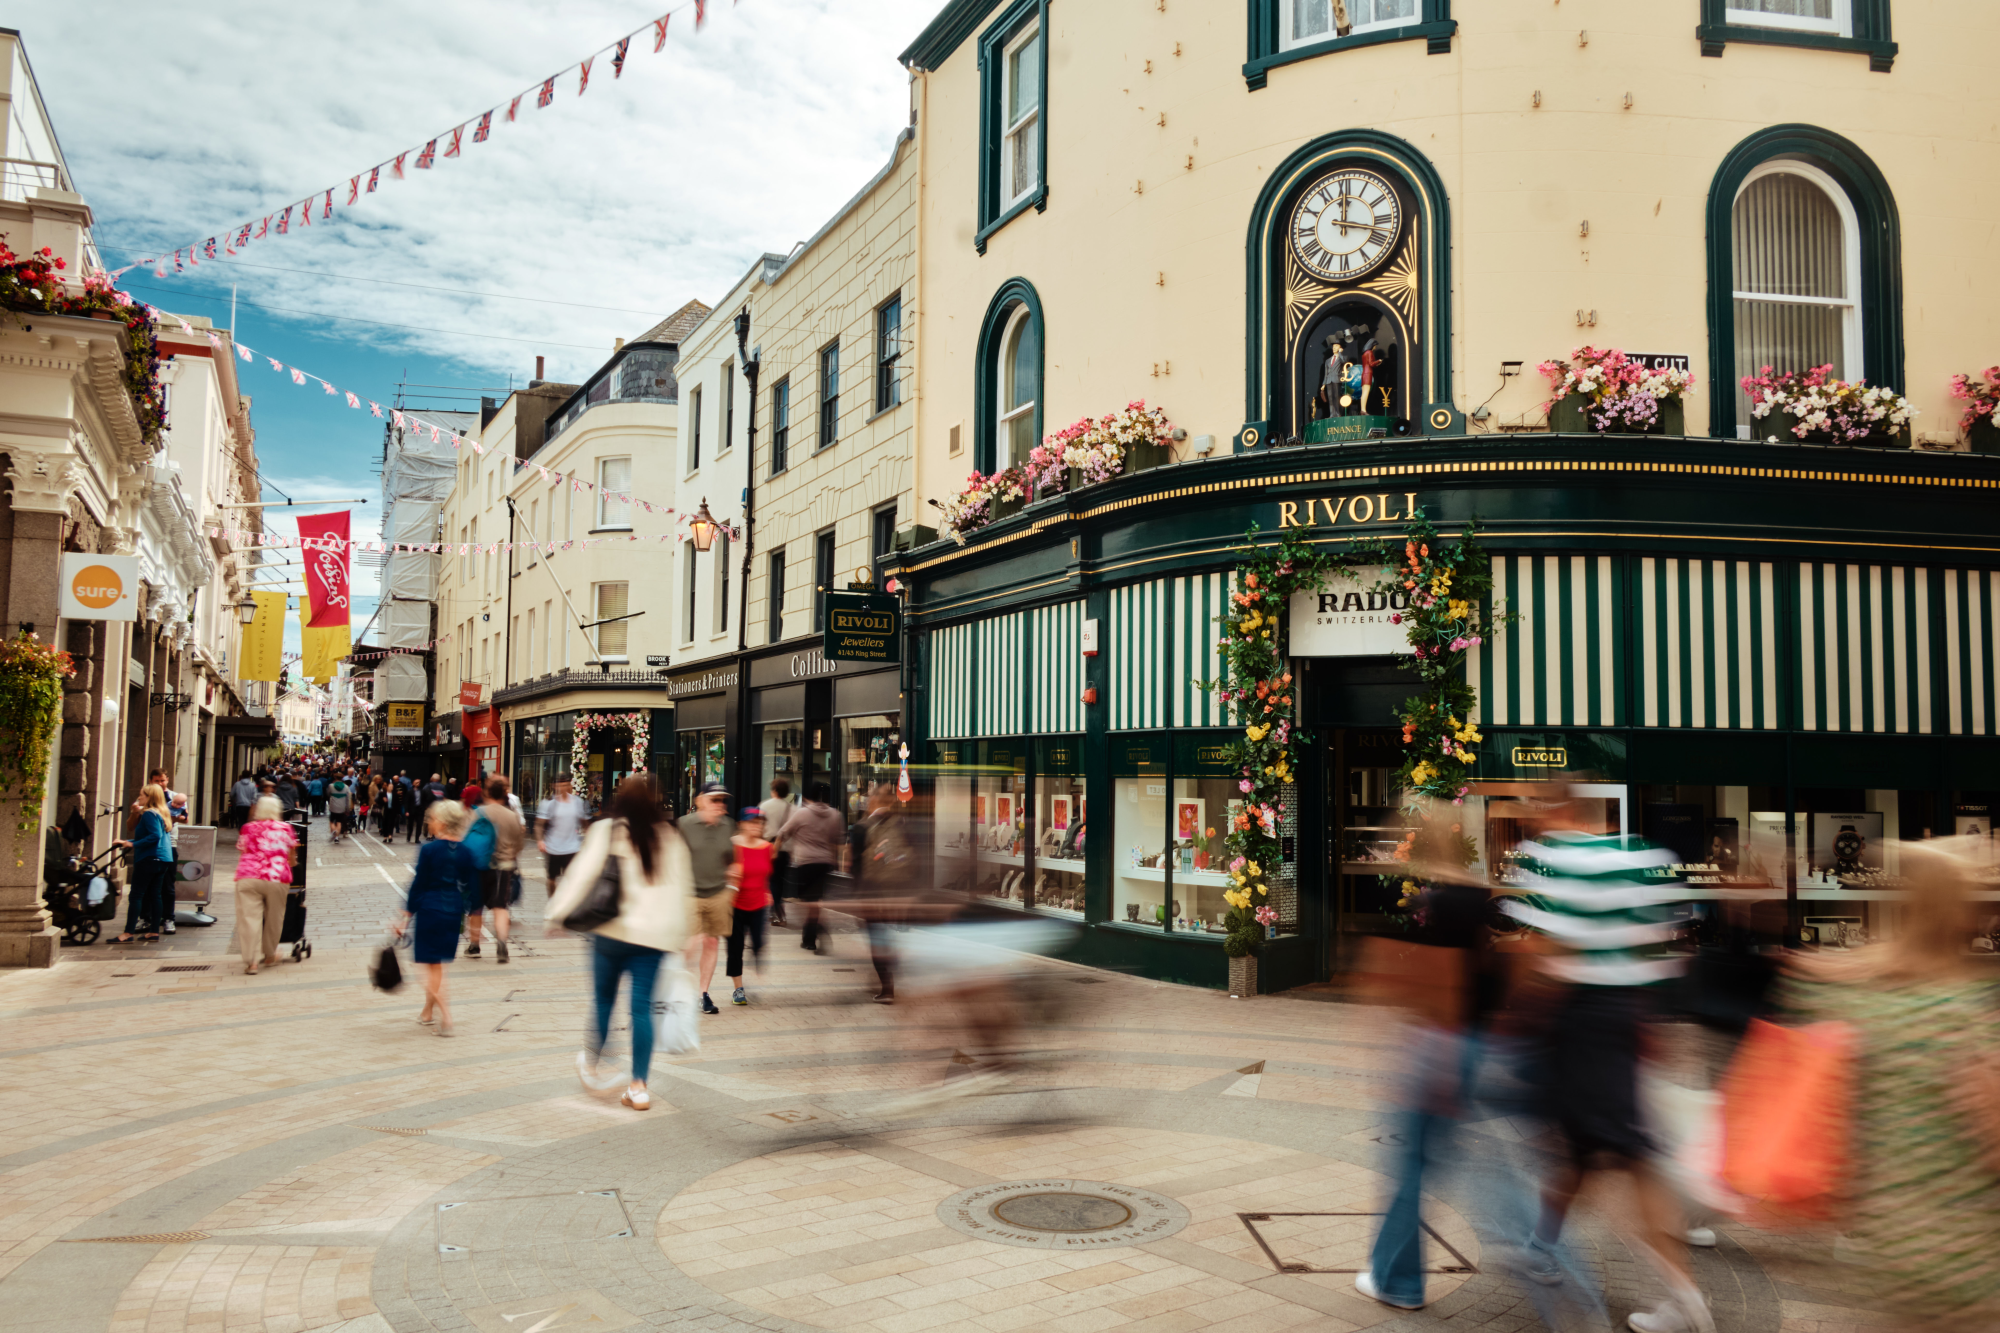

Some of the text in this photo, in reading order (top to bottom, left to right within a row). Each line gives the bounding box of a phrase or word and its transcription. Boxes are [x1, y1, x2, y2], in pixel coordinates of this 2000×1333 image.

[1327, 425, 1362, 436] FINANCE
[1278, 492, 1418, 528] RIVOLI
[1317, 590, 1412, 614] RADO
[837, 615, 889, 628] RIVOLI
[1317, 615, 1391, 626] SWITZERLA
[840, 636, 885, 648] Jewellers
[792, 651, 836, 677] Collins
[1128, 752, 1148, 760] RIVOLI
[1518, 752, 1562, 762] RIVOLI
[960, 1182, 1065, 1206] Cartographer
[1102, 1186, 1136, 1197] Map
[958, 1209, 1040, 1244] Saint Helier
[1066, 1218, 1170, 1246] Elias le Gros
